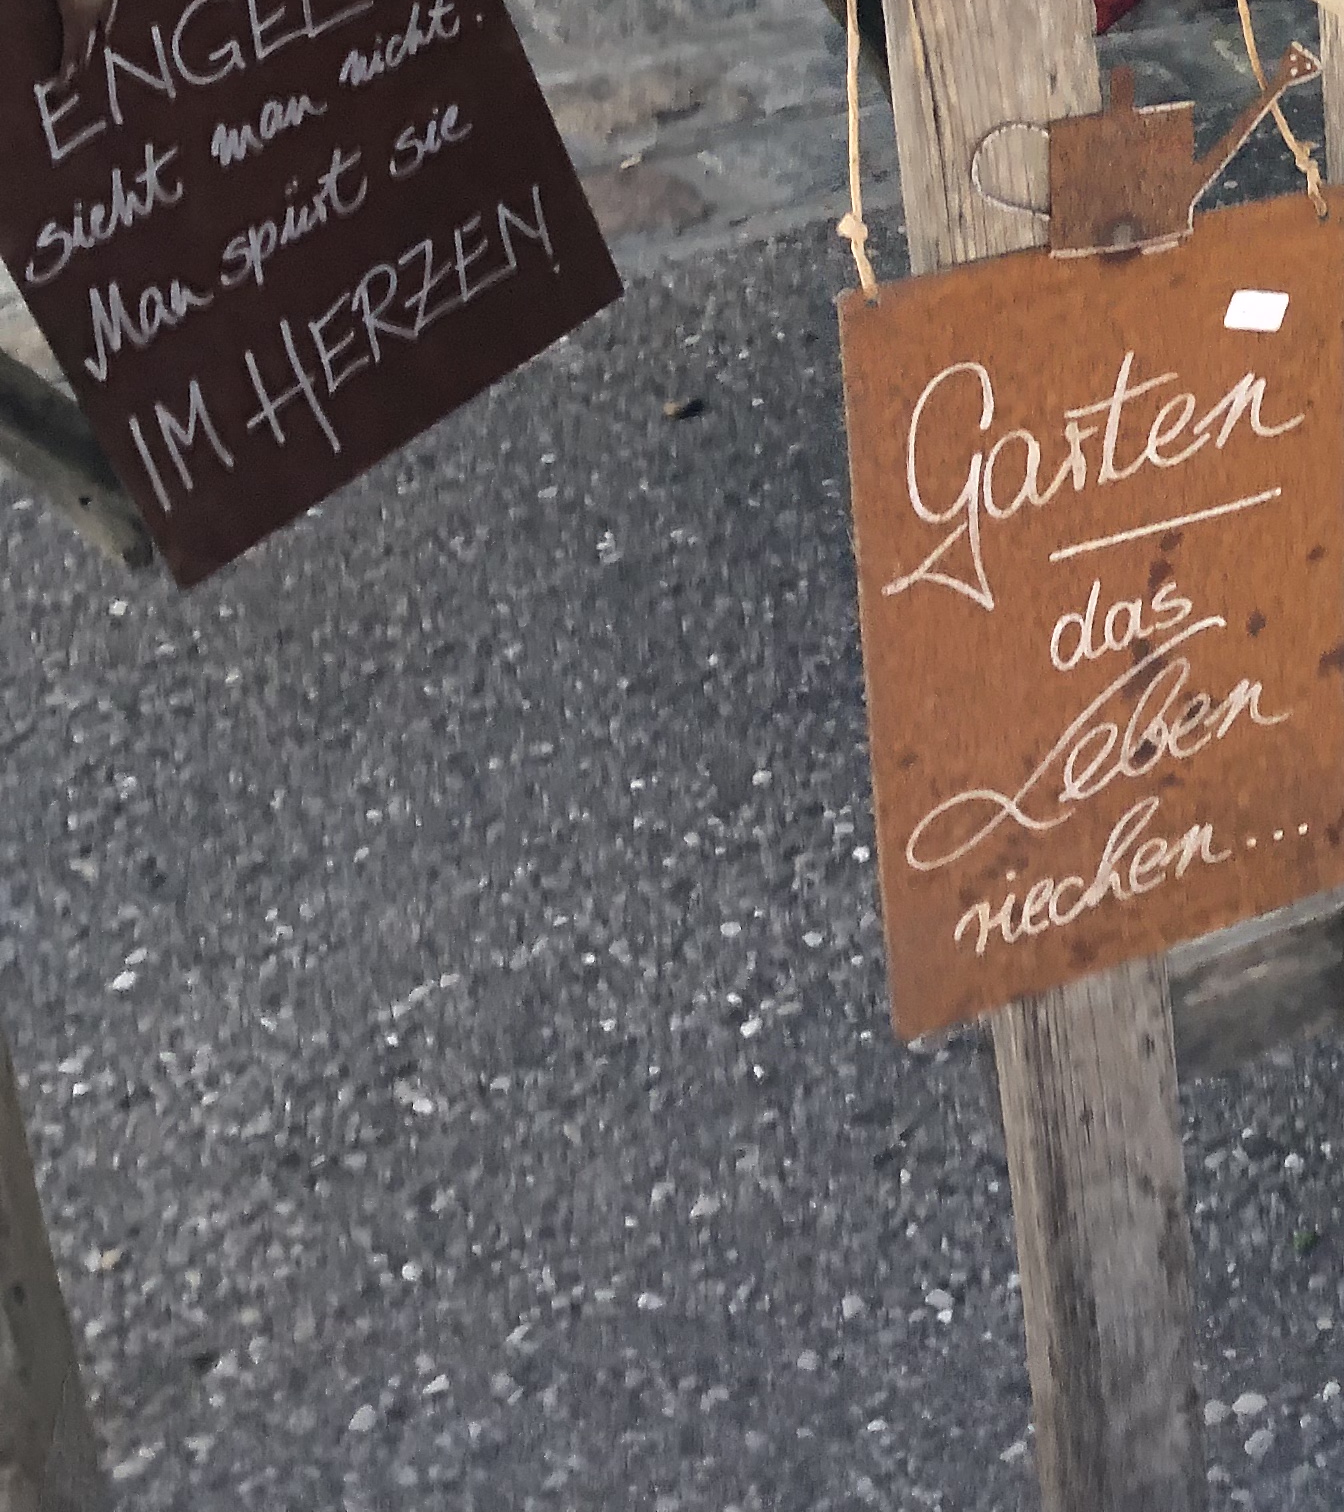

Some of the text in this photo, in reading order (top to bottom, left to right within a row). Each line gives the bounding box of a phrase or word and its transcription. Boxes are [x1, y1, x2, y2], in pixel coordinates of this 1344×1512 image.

[83, 100, 474, 385] Man spürt sie
[212, 91, 327, 168] man
[127, 184, 563, 513] IM HERZEN!
[882, 350, 1304, 611] Garten
[905, 615, 1293, 872] Leben
[1049, 578, 1195, 673] das
